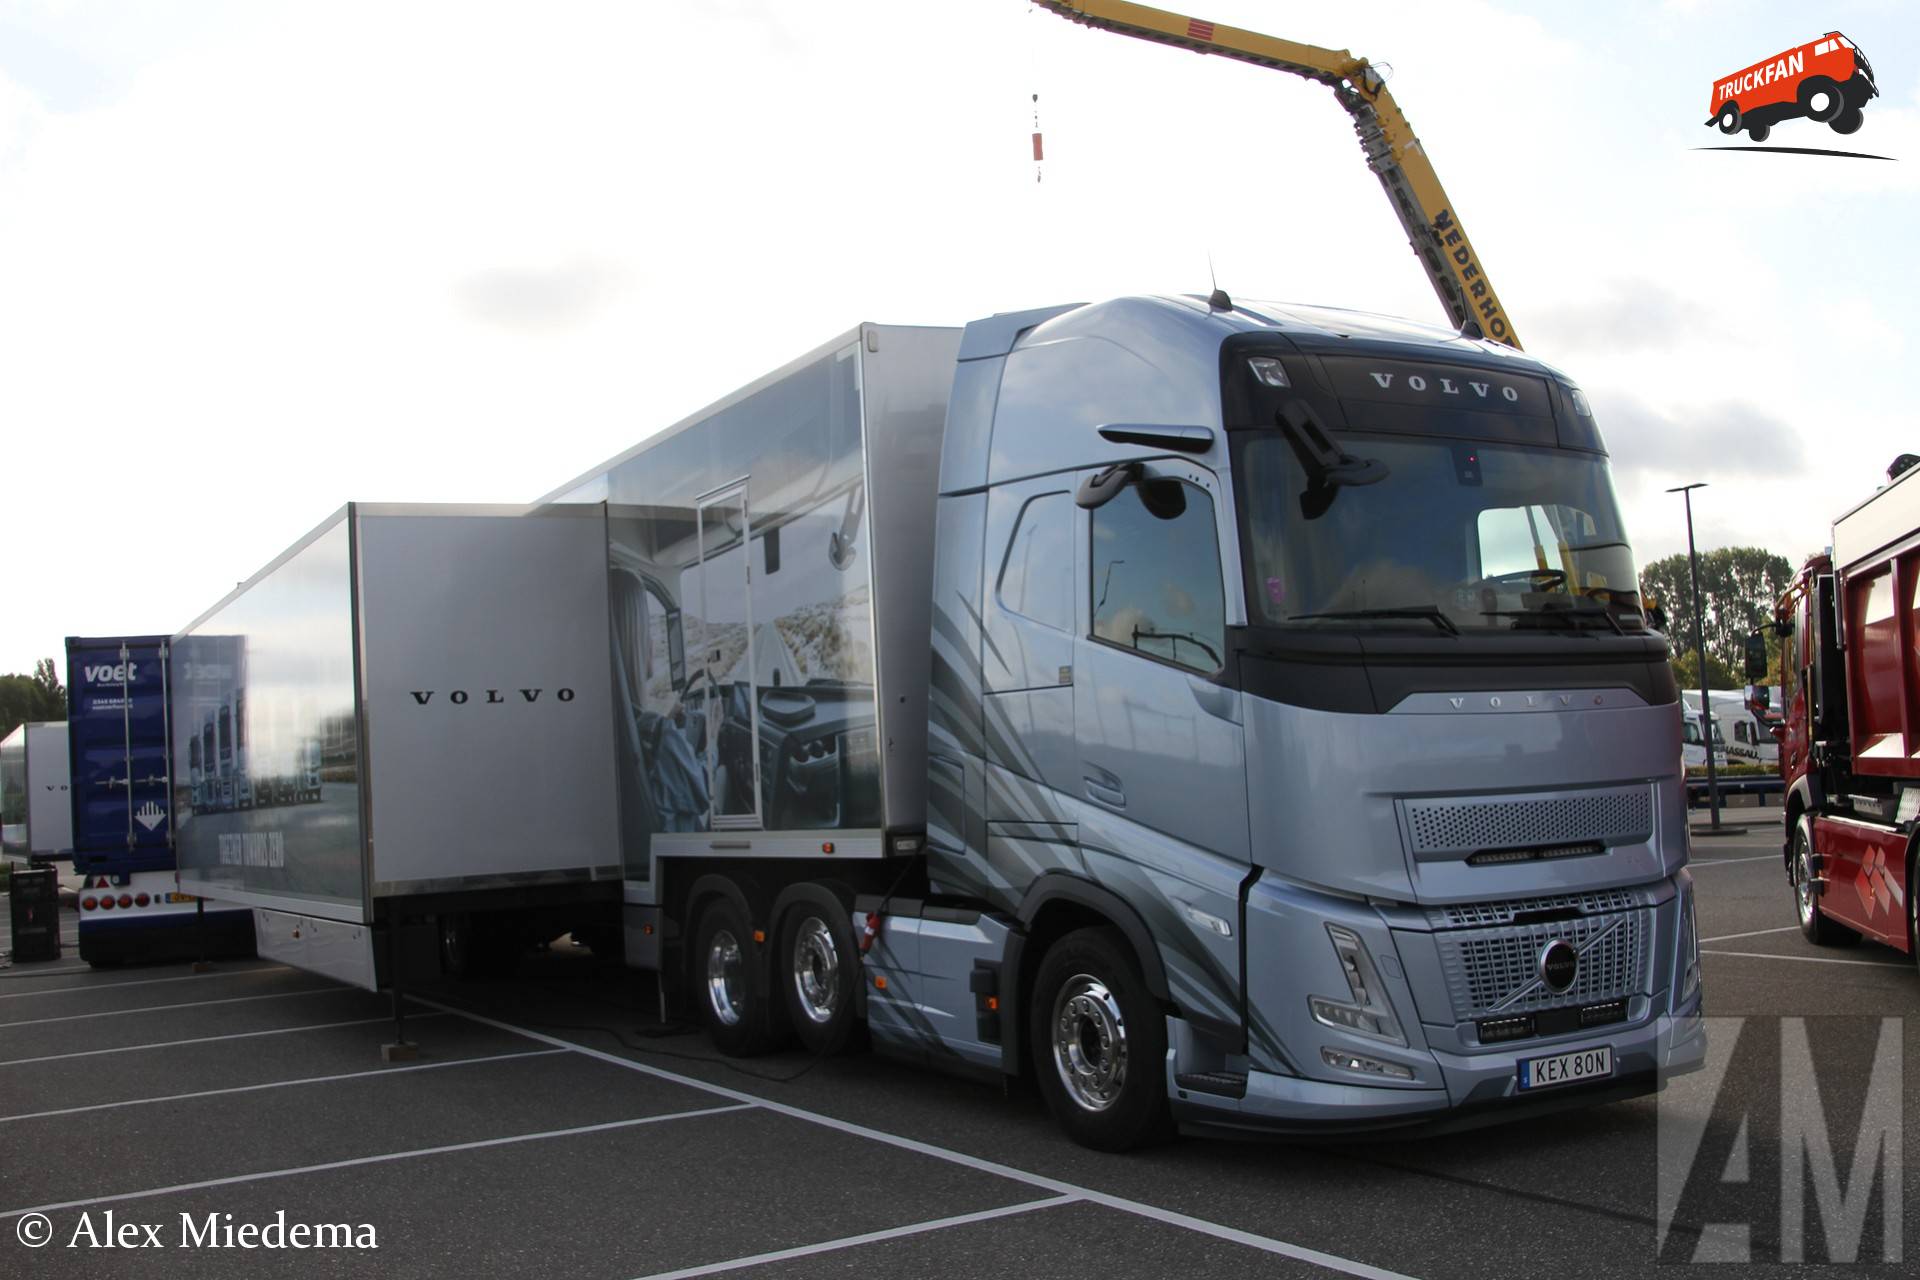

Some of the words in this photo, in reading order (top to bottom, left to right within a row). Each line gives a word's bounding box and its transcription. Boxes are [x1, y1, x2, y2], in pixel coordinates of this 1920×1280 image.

[1369, 372, 1518, 402] VOLVO
[84, 661, 137, 683] voet
[410, 688, 575, 705] VOLVO
[1449, 694, 1604, 709] VOLVO
[1536, 1056, 1569, 1083] KEX
